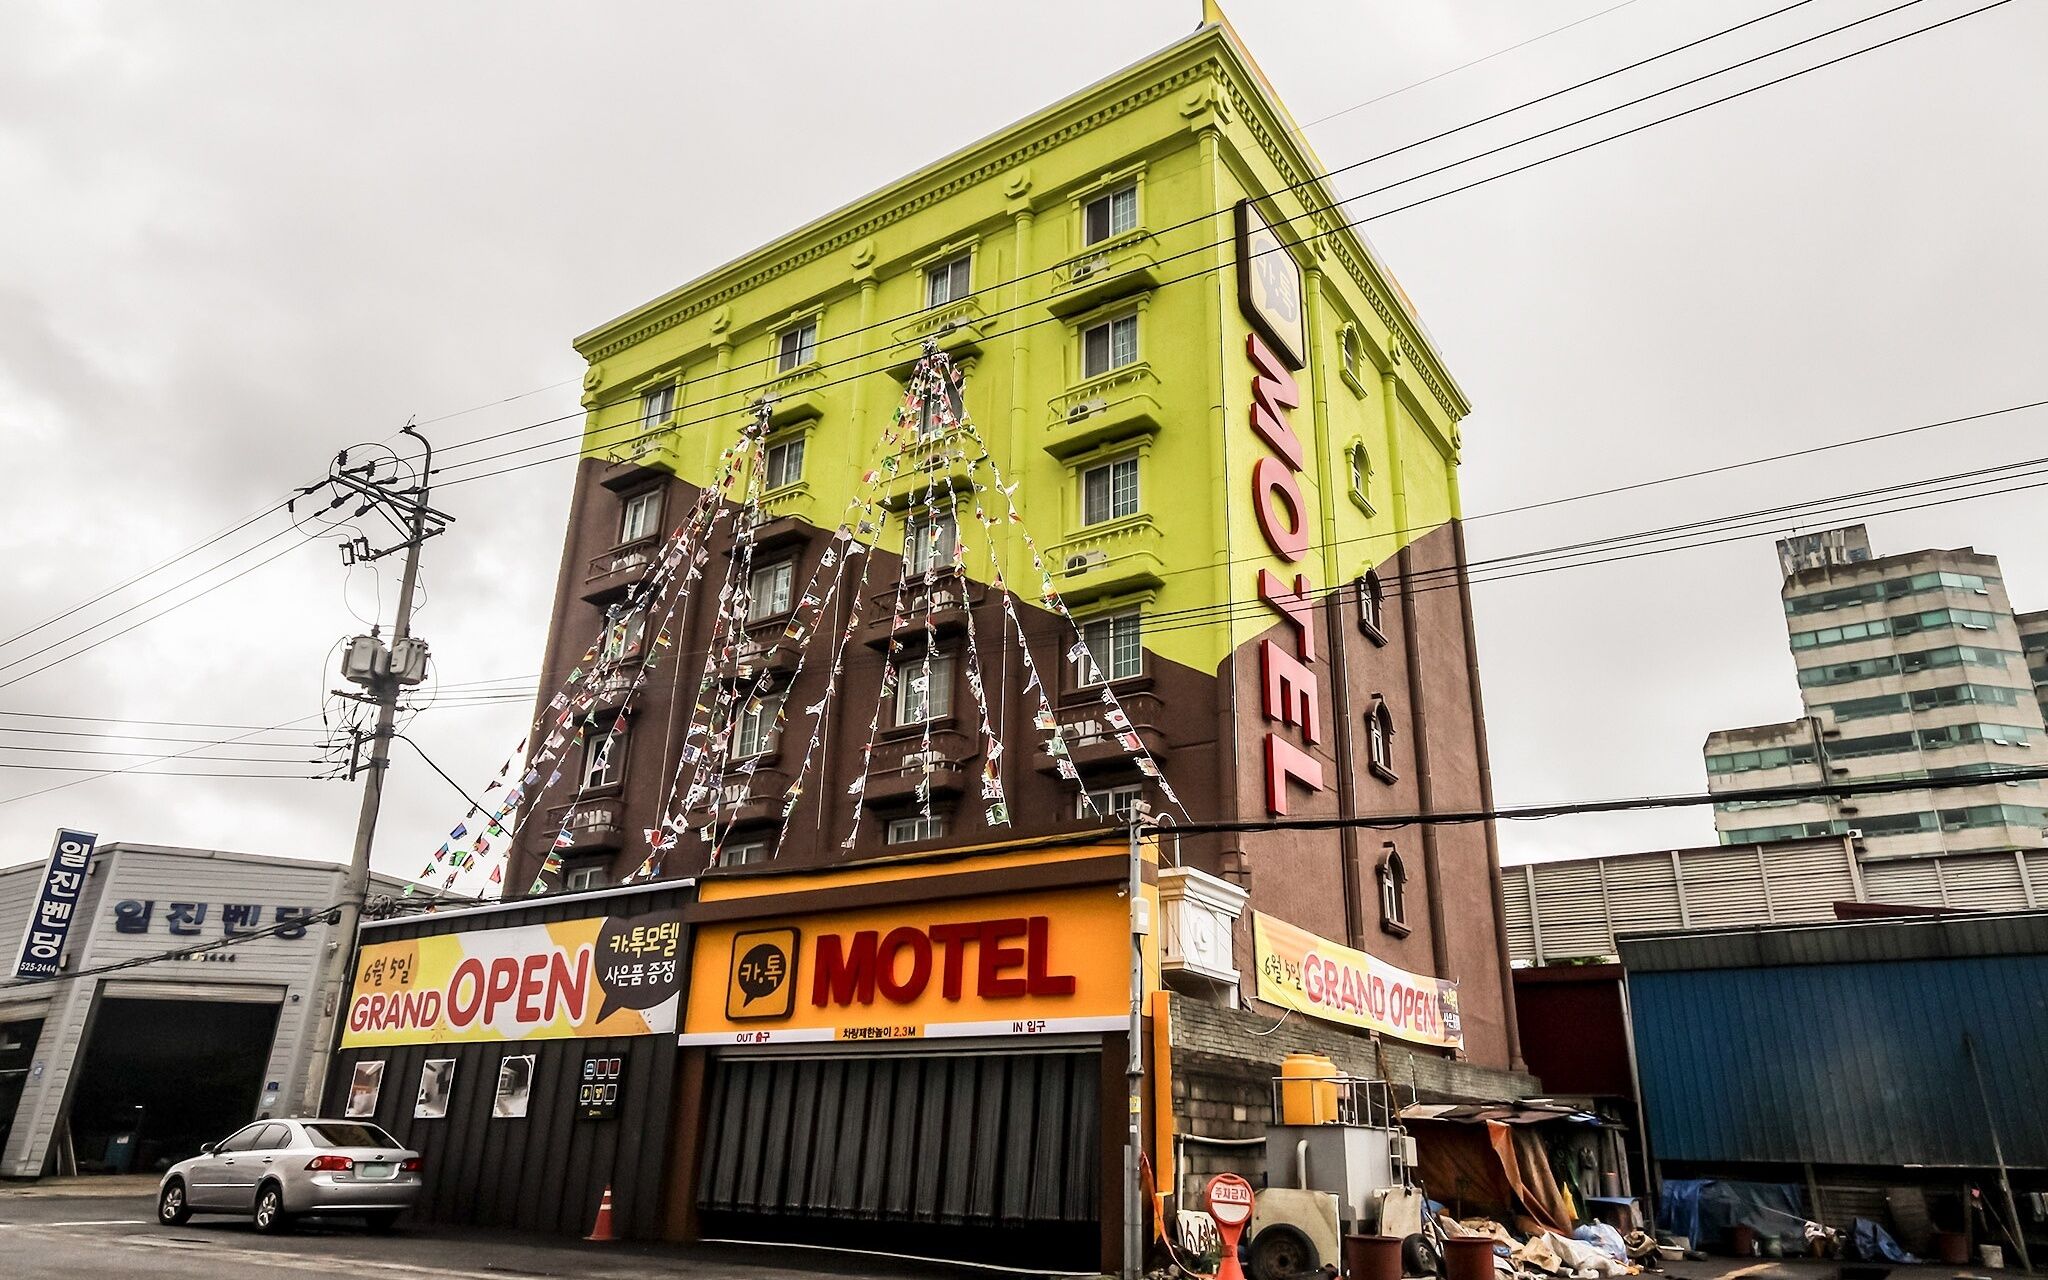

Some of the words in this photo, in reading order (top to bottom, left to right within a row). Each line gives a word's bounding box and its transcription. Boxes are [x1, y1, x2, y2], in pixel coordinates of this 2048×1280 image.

[1247, 332, 1323, 816] MOTEL
[30, 841, 91, 959] 일진벤딩
[115, 900, 314, 940] 일진벤딩
[20, 962, 56, 973] 525-2444
[363, 956, 388, 986] 6월
[390, 953, 413, 984] 5일
[604, 963, 645, 987] 사은품
[647, 960, 677, 985] 증정
[811, 915, 1076, 1008] MOTEL
[1265, 954, 1282, 985] 6월
[1285, 959, 1302, 991] 5일
[350, 991, 441, 1032] GRAND
[447, 949, 590, 1028] OPEN
[1304, 954, 1385, 1022] GRAND
[1390, 982, 1438, 1034] OPEN
[736, 1032, 753, 1043] OUT
[893, 1025, 916, 1037] 2.3M
[1012, 1021, 1023, 1033] IN
[1026, 1020, 1046, 1033] 입구
